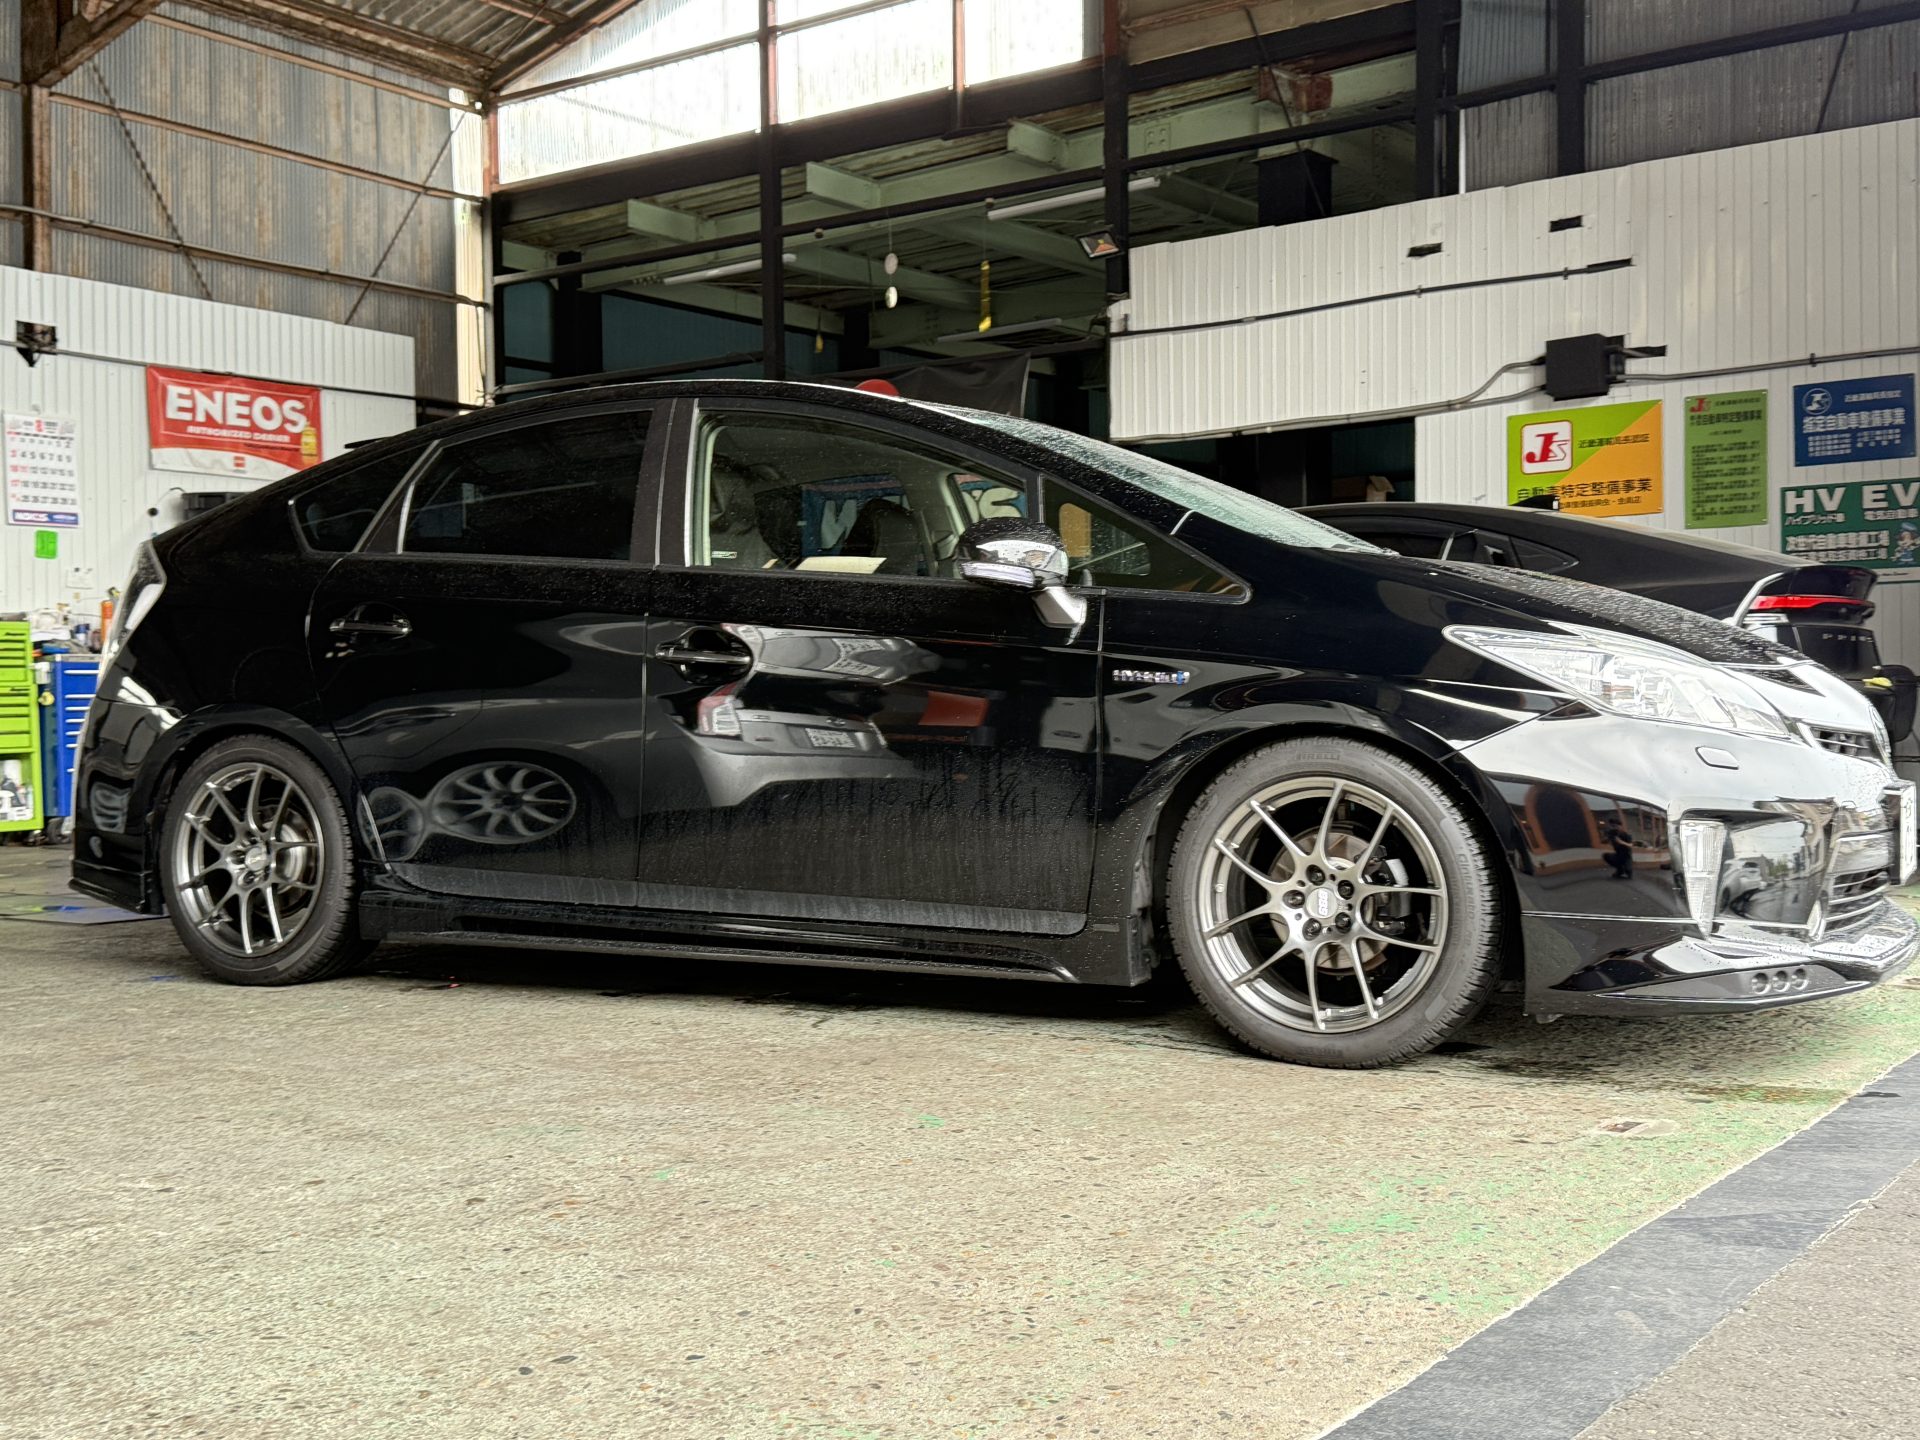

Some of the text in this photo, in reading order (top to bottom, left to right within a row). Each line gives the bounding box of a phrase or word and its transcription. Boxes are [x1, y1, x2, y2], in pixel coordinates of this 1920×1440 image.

[166, 385, 308, 434] ENEOS
[1785, 482, 1920, 514] HV EV
